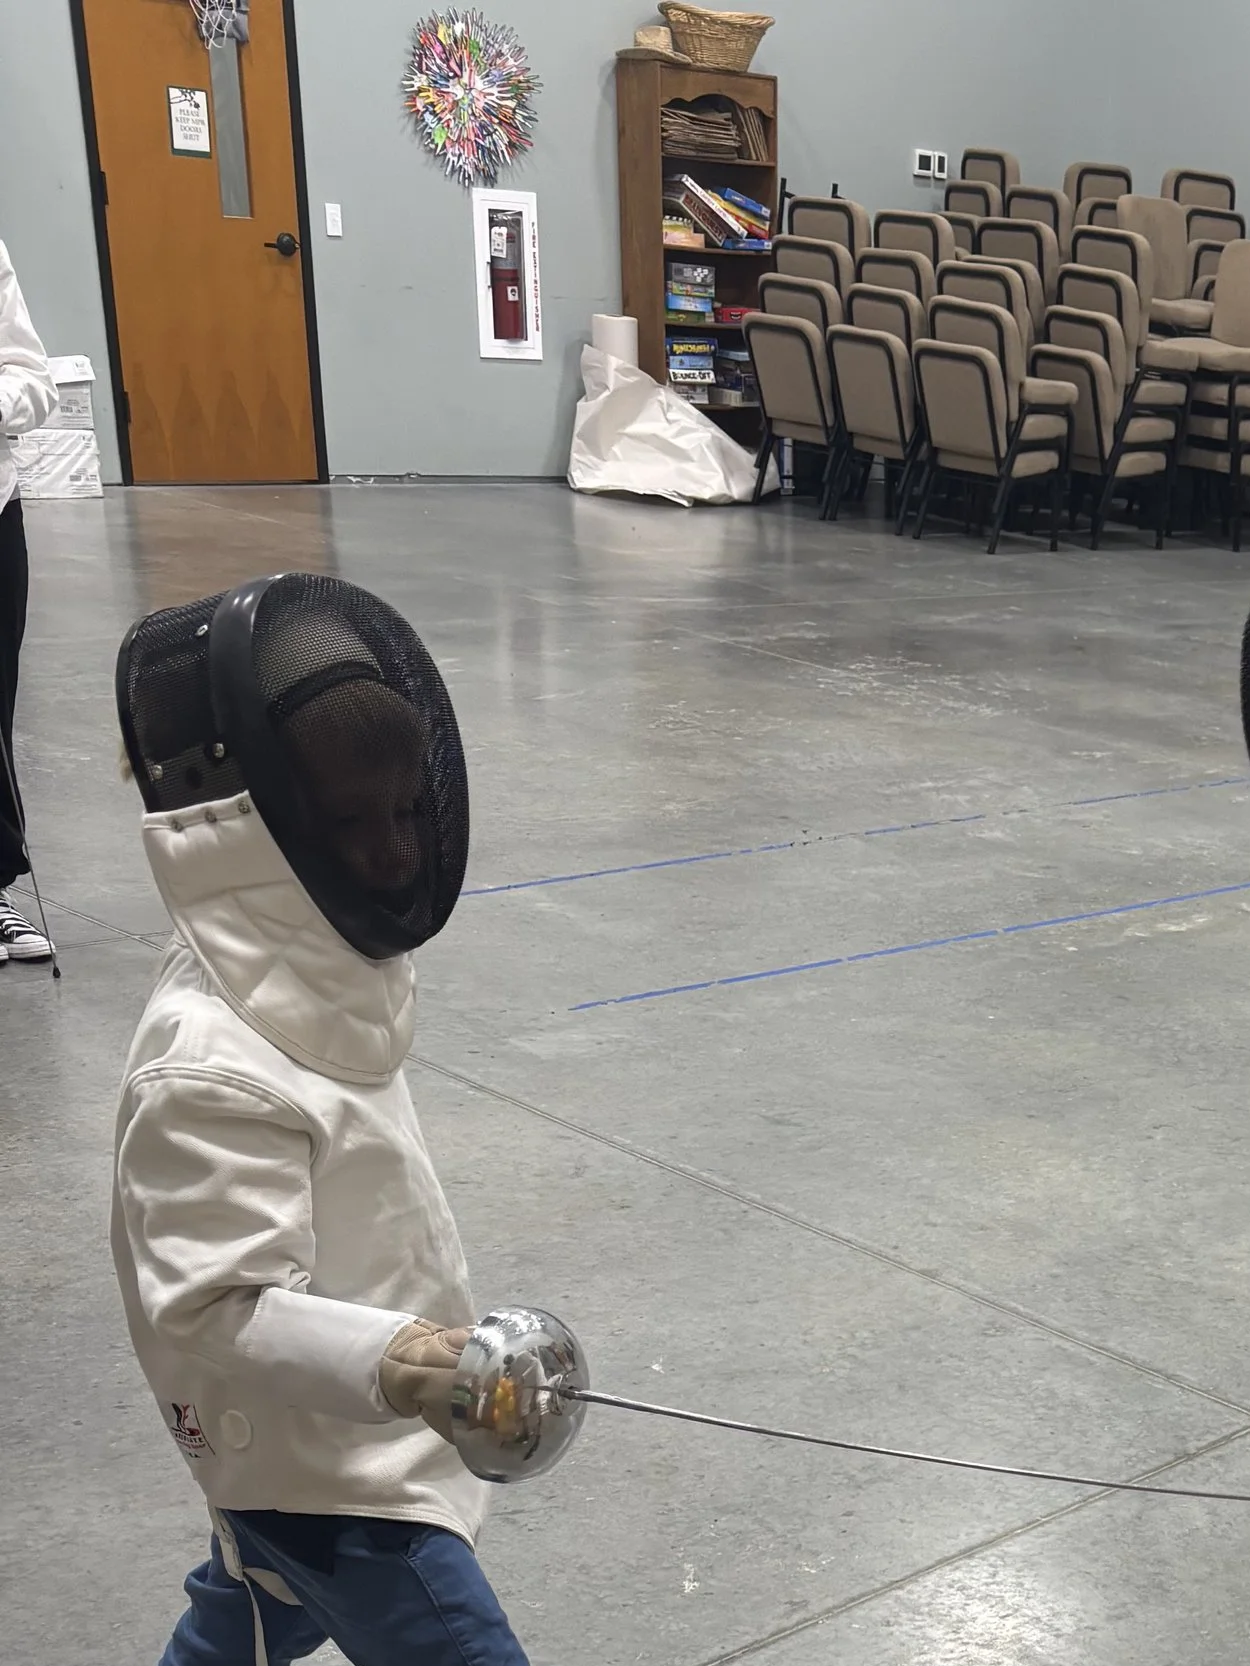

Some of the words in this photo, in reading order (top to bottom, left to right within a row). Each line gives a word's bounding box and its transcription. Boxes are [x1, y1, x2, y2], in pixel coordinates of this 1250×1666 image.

[179, 108, 200, 117] PLEASE
[175, 116, 190, 124] KEEP
[180, 125, 202, 133] DOORS
[183, 133, 200, 141] SHUT
[532, 251, 540, 332] EXTINGUISHER
